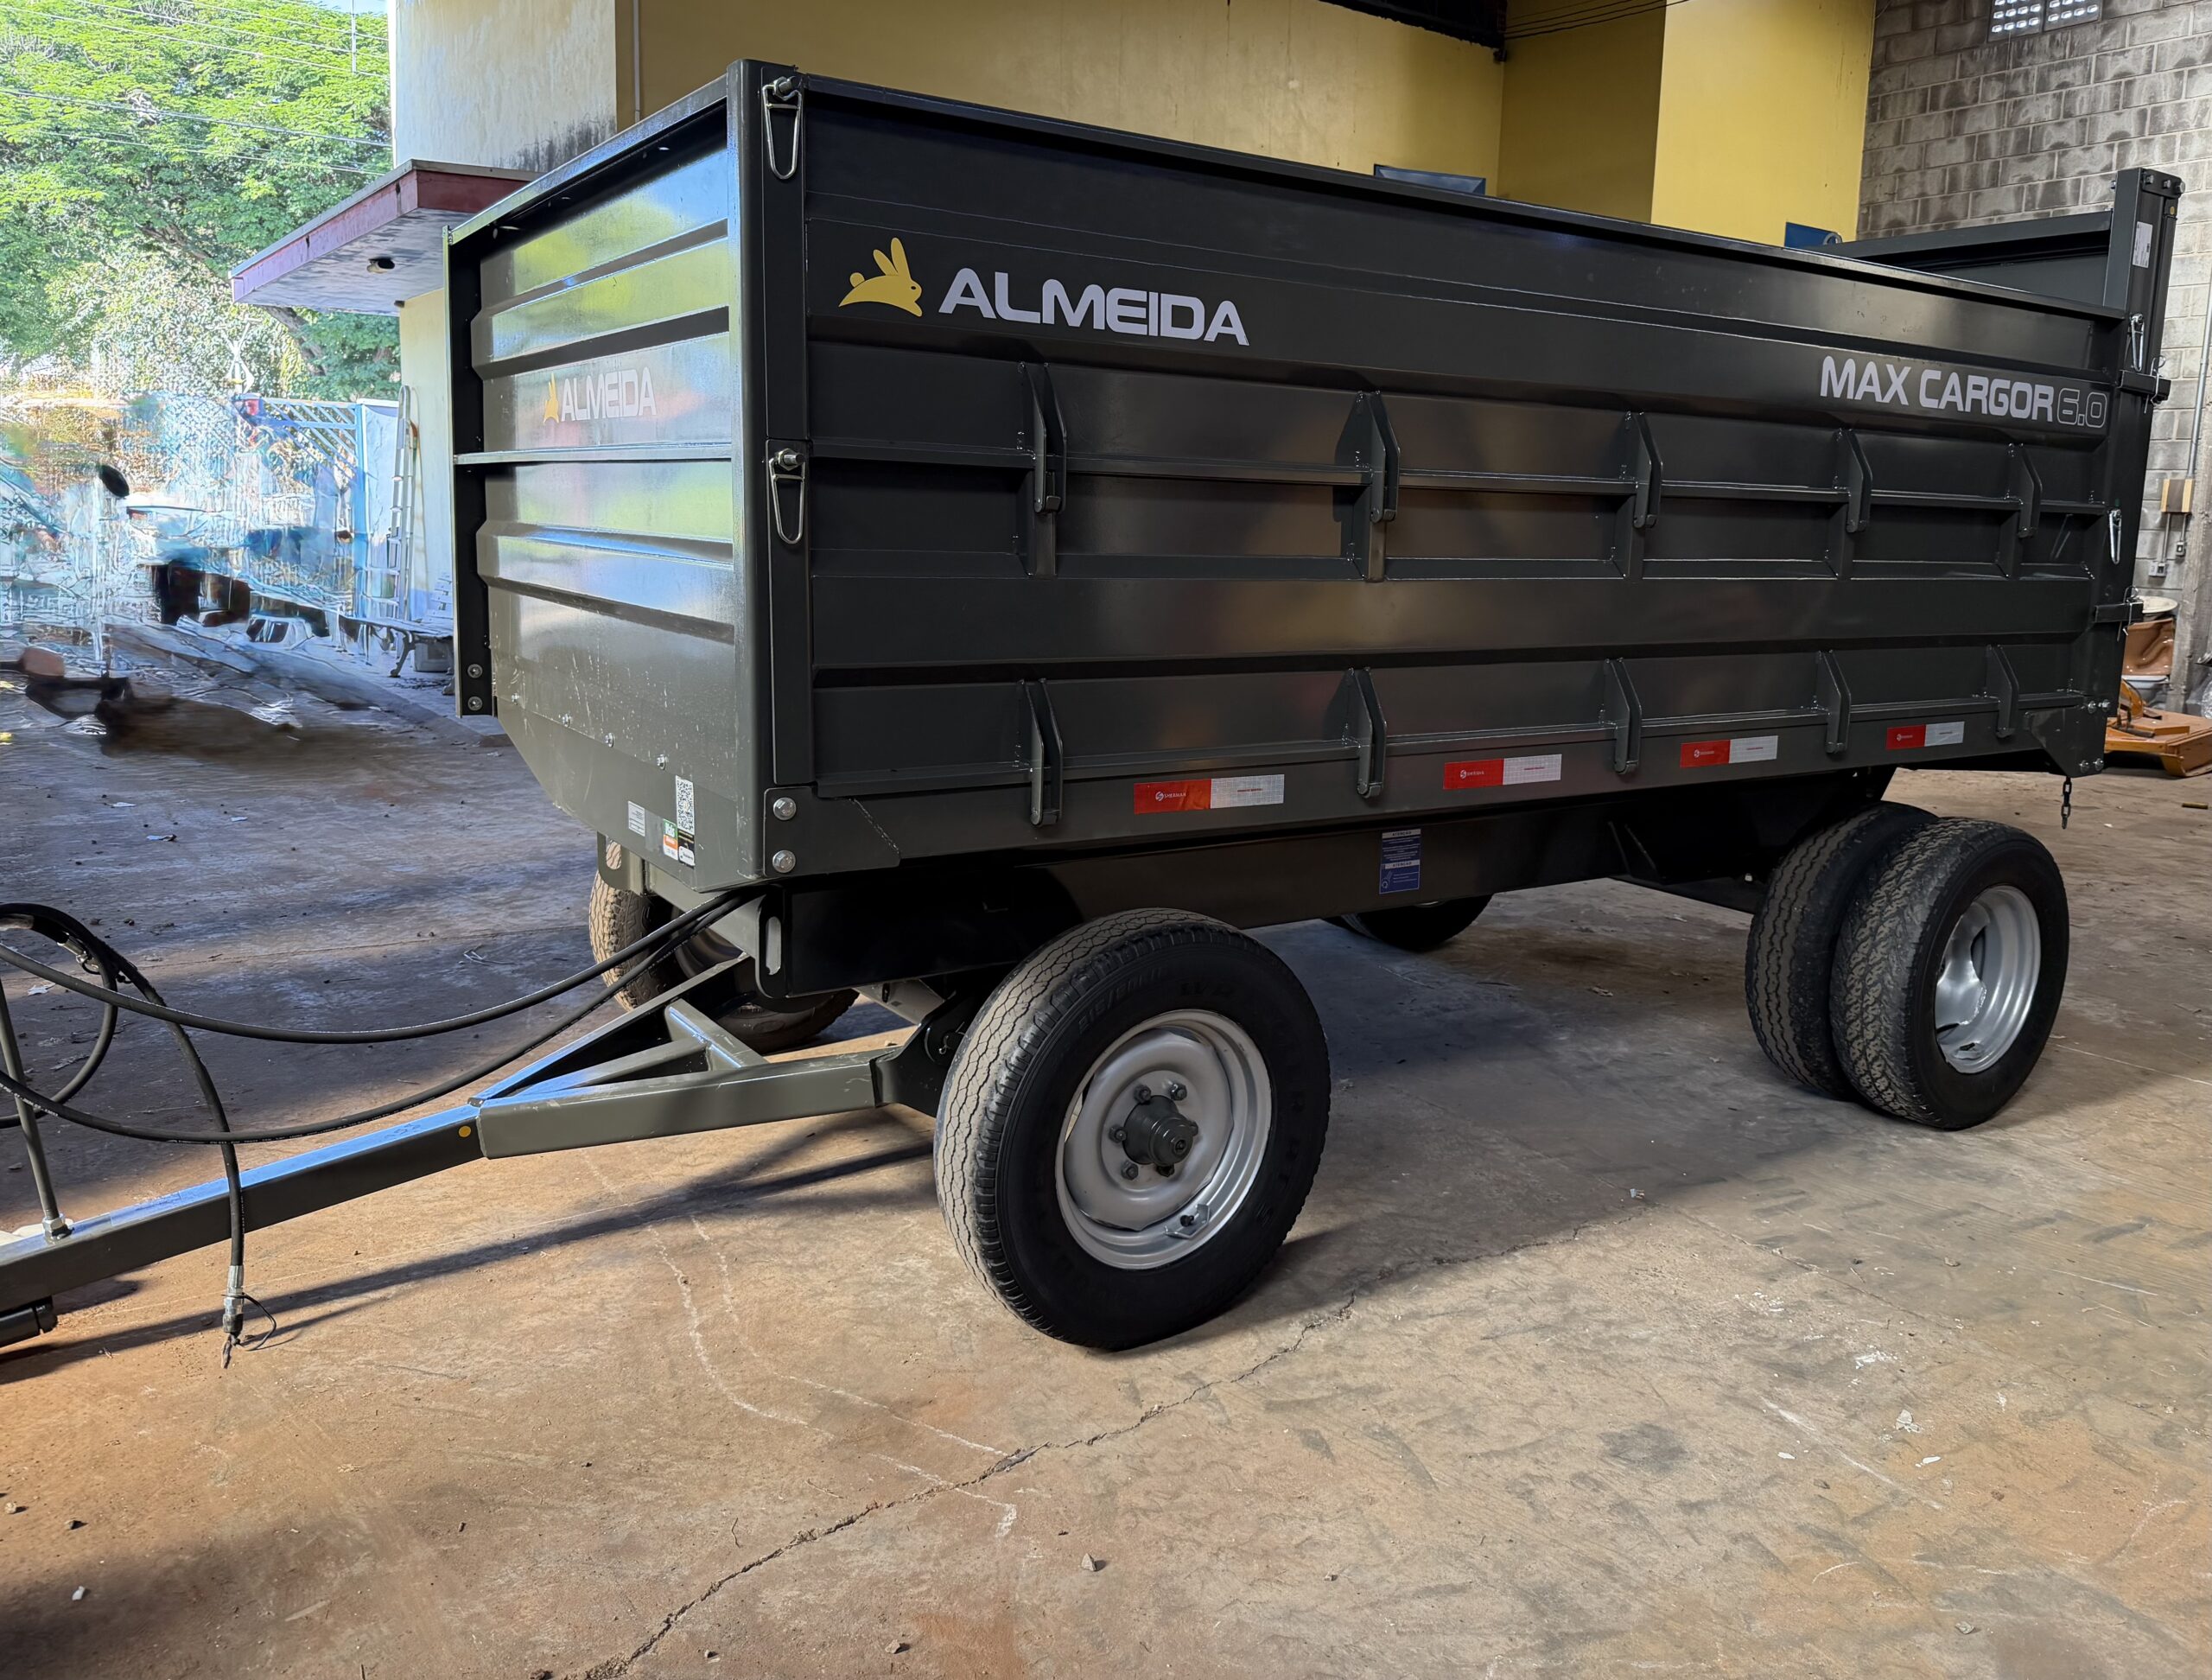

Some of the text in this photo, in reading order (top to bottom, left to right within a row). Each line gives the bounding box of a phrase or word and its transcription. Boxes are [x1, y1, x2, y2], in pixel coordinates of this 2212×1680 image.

[938, 267, 1249, 347] ALMEIDA
[562, 366, 657, 422] ALMEIDA
[1820, 355, 2107, 429] MAX CARGOR 6.0
